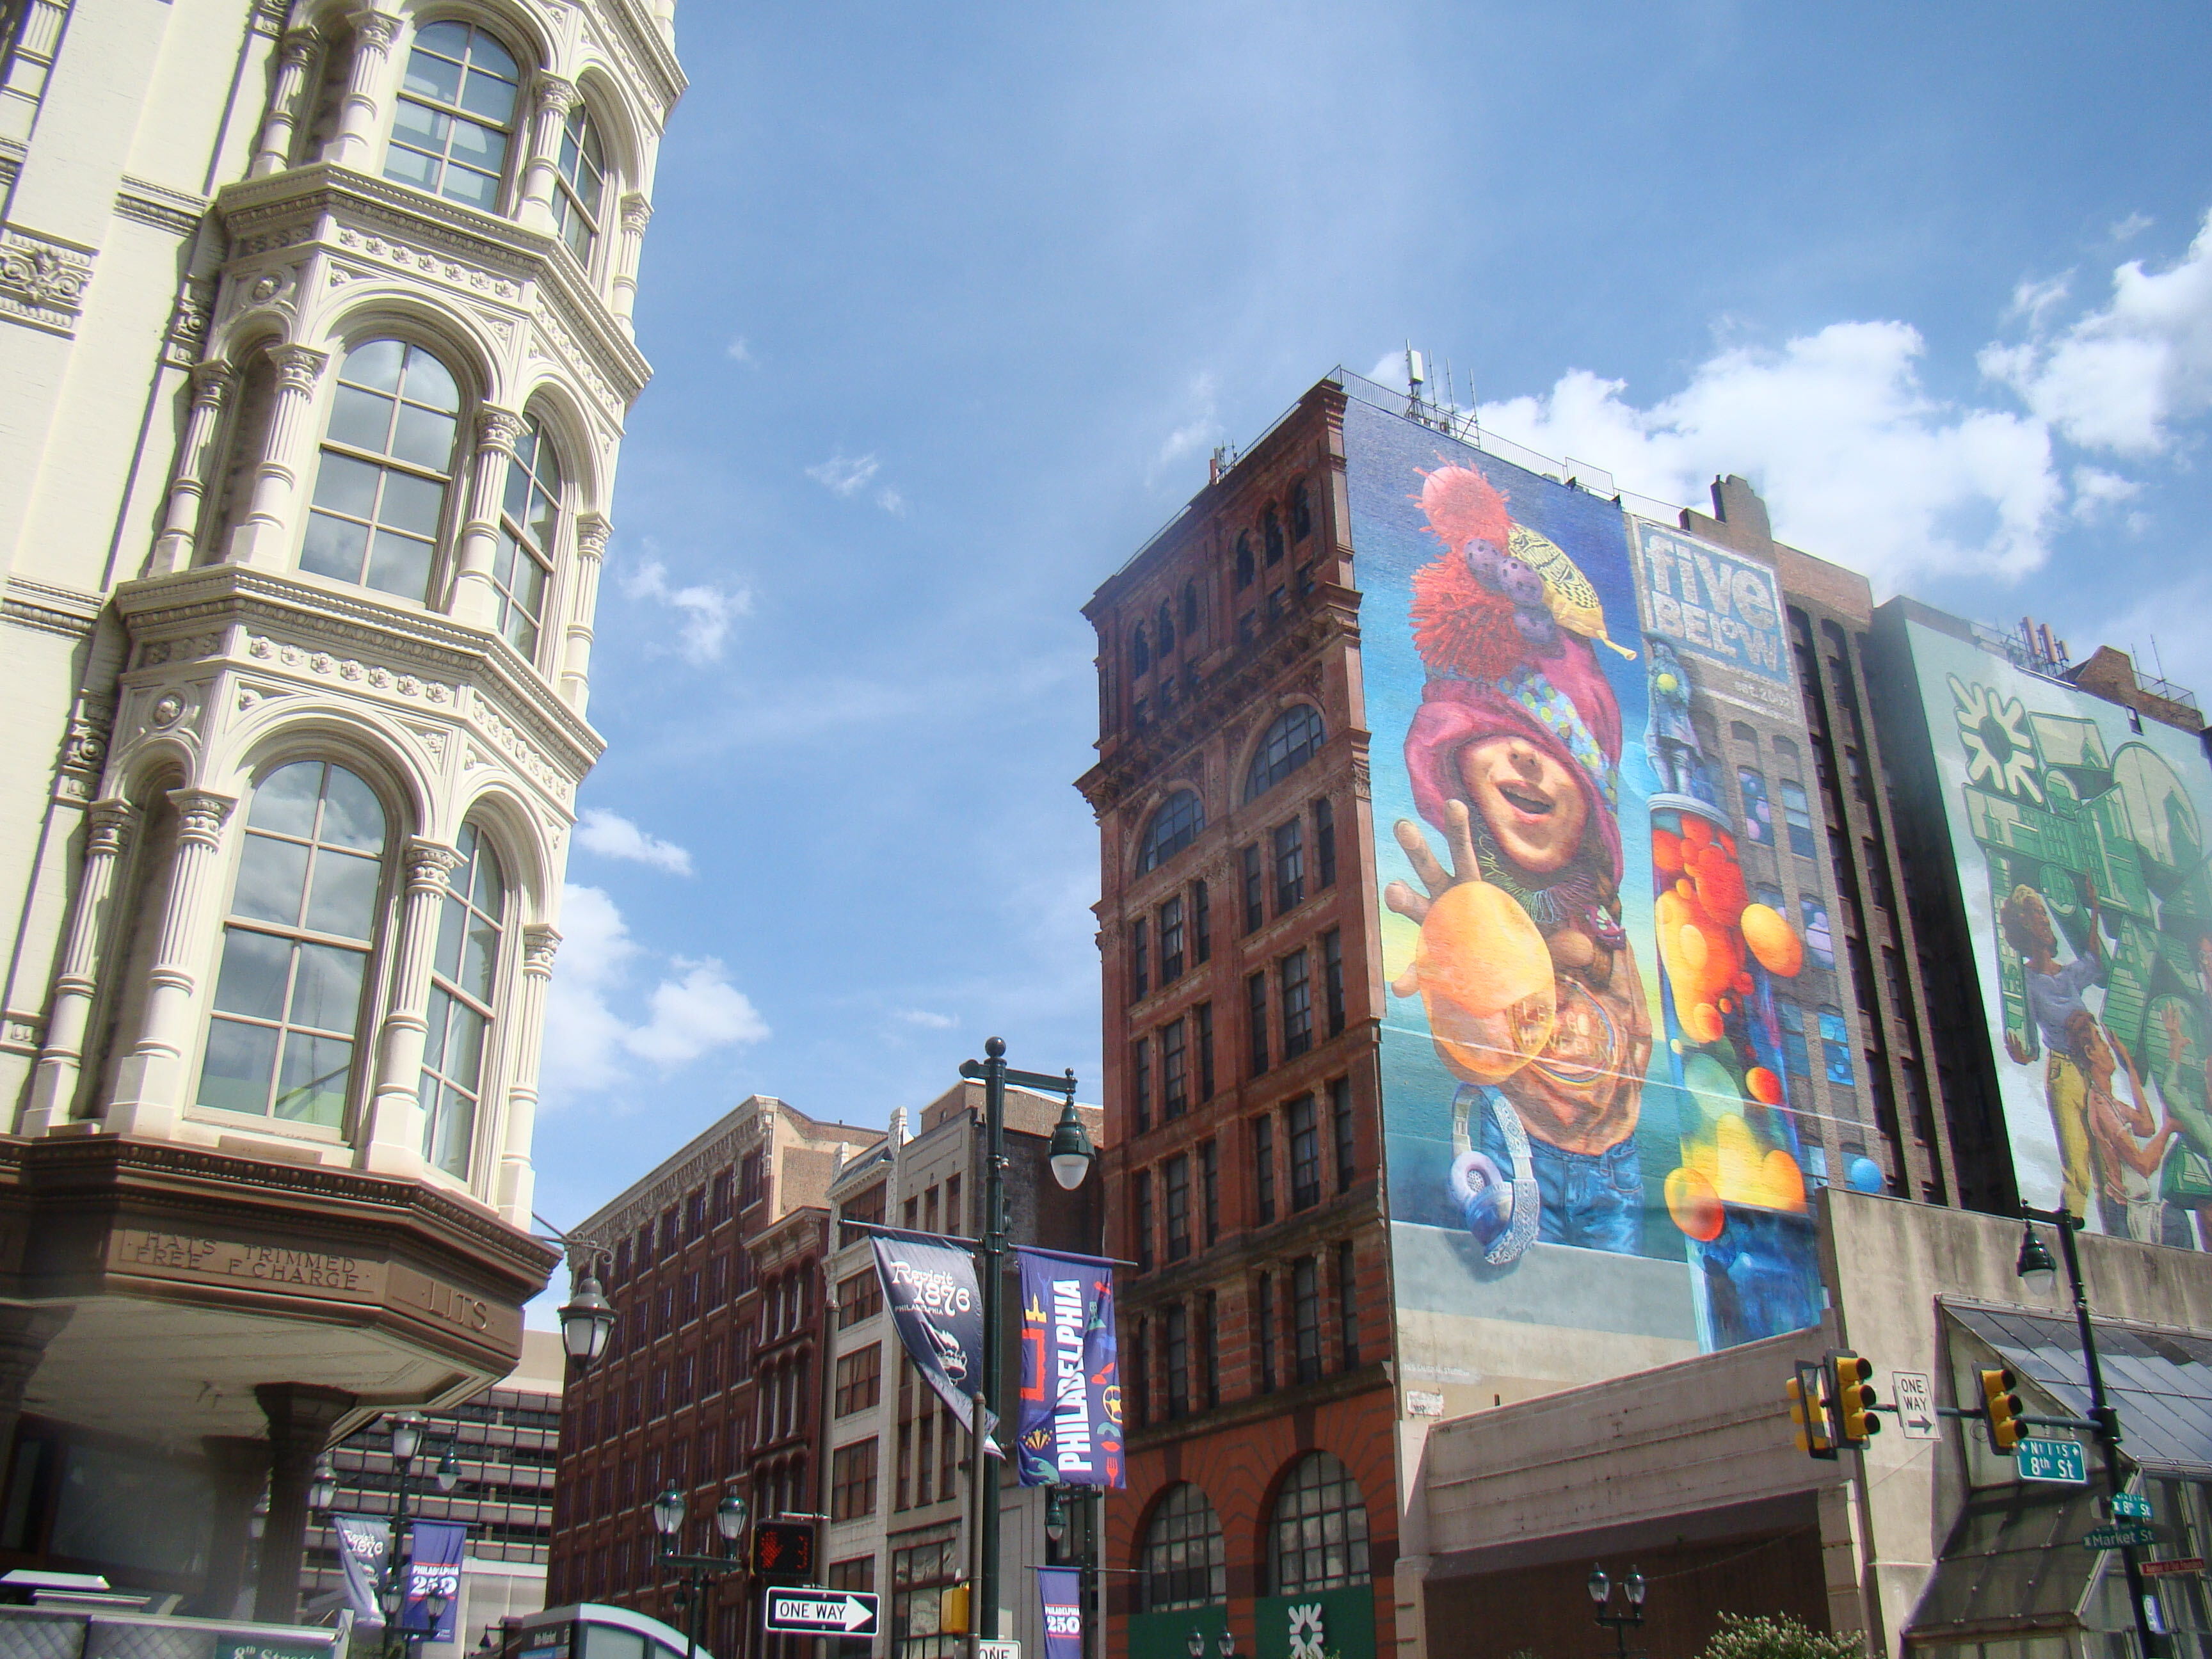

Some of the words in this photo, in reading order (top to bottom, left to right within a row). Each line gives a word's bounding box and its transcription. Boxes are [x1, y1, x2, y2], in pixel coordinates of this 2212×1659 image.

[1651, 590, 1778, 671] BELOW
[136, 1246, 204, 1269] FREE
[253, 1263, 359, 1290] CHARGE
[244, 1245, 356, 1274] TRIMMED
[429, 1280, 487, 1332] LITS
[913, 1280, 970, 1317] 1876
[1053, 1279, 1093, 1471] PHILADELPHIA
[1901, 1379, 1925, 1393] ONE
[1903, 1396, 1927, 1411] WAY
[2030, 1457, 2051, 1476] 8th
[2058, 1459, 2075, 1479] St
[2140, 1503, 2151, 1516] St
[2092, 1531, 2136, 1547] Market
[2140, 1528, 2155, 1542] St
[780, 1601, 810, 1618] ONE
[815, 1604, 846, 1620] WAY
[1047, 1615, 1080, 1634] 250
[981, 1647, 1010, 1659] ONE
